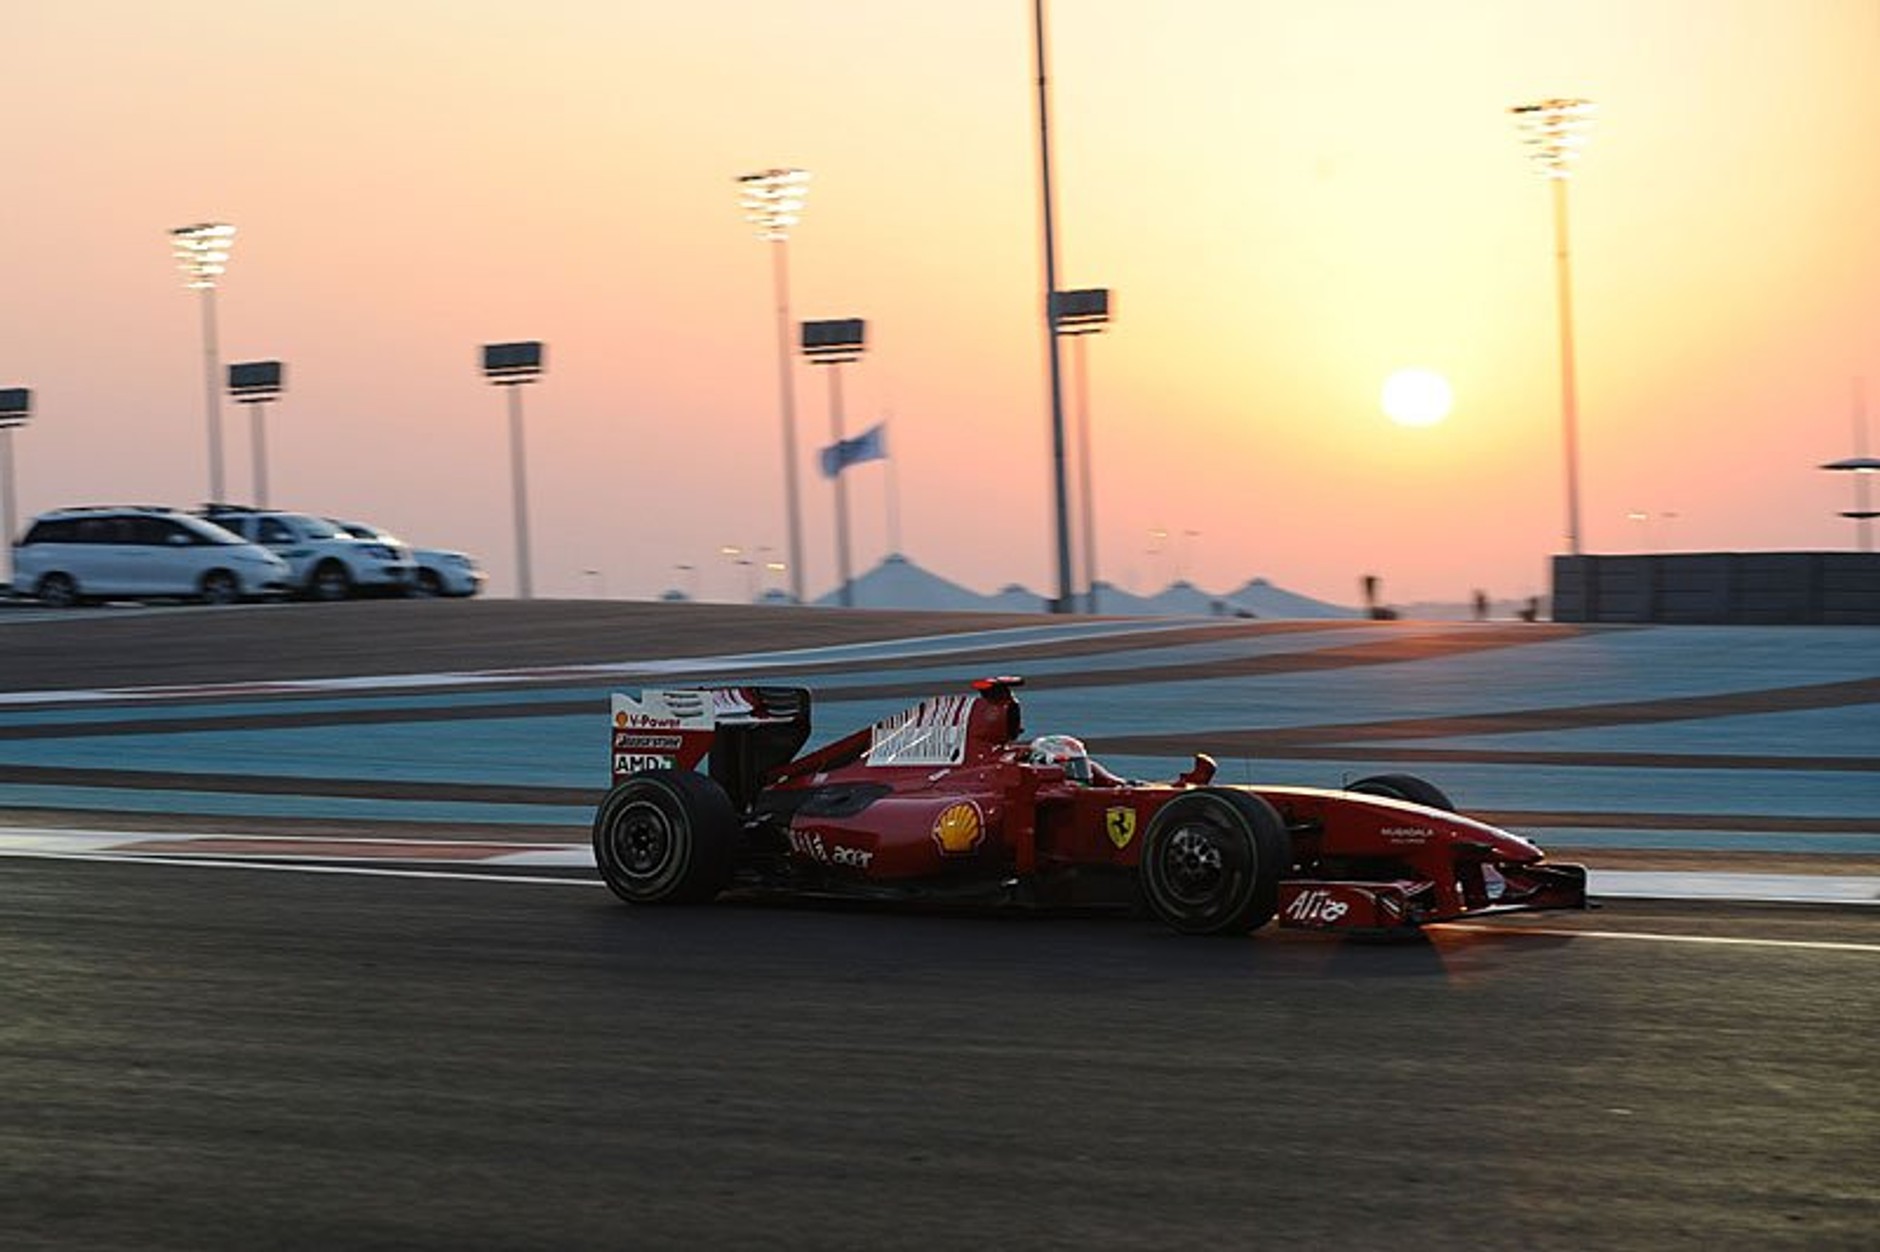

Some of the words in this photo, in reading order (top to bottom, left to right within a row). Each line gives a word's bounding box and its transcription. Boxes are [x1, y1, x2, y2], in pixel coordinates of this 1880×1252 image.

[630, 713, 681, 728] V-Power
[616, 755, 660, 772] AMD
[833, 845, 874, 869] acer
